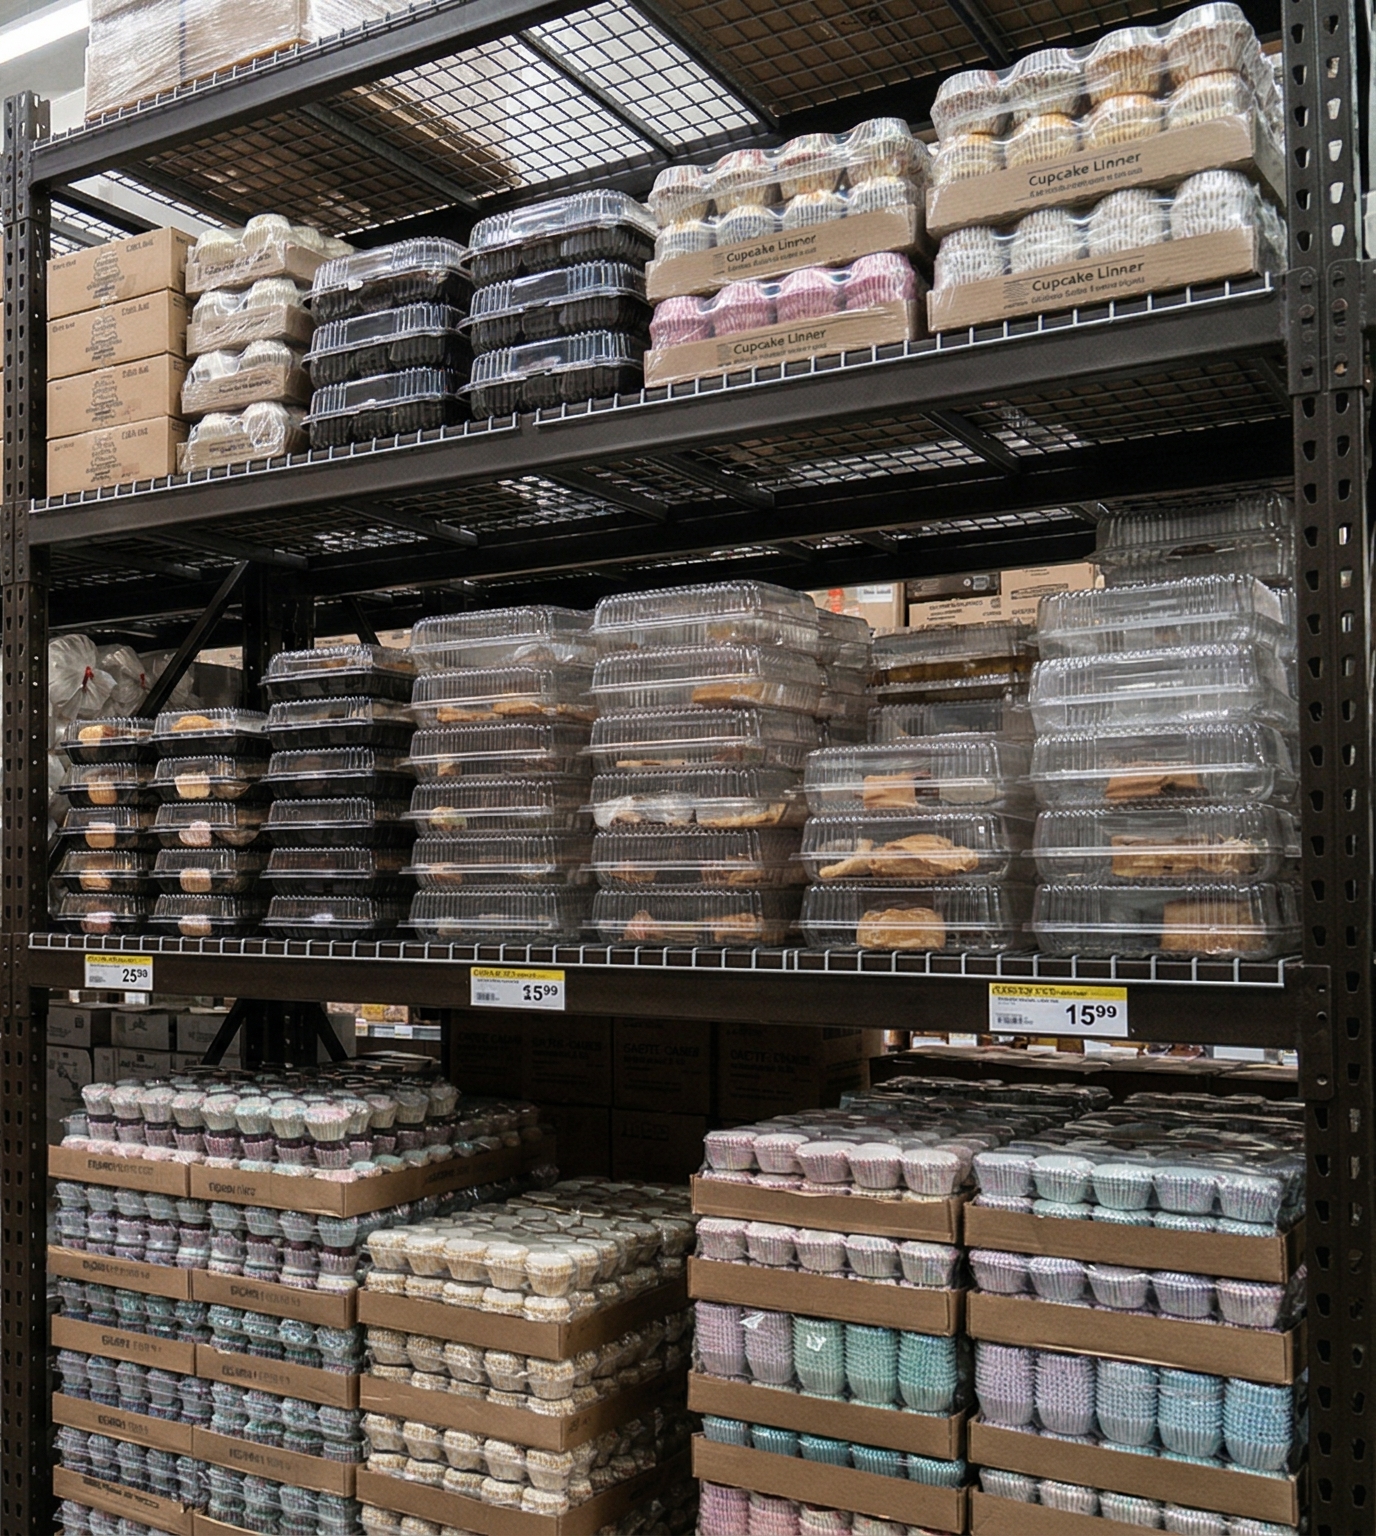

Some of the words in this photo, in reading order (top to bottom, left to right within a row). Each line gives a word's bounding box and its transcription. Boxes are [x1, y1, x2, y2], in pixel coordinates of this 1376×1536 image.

[1028, 164, 1089, 187] Cupcake
[1093, 153, 1142, 172] Linner
[726, 243, 776, 263] Cupcake
[1032, 272, 1094, 292] Cupcake
[1097, 262, 1145, 279] Linner
[733, 337, 785, 355] Cupcake
